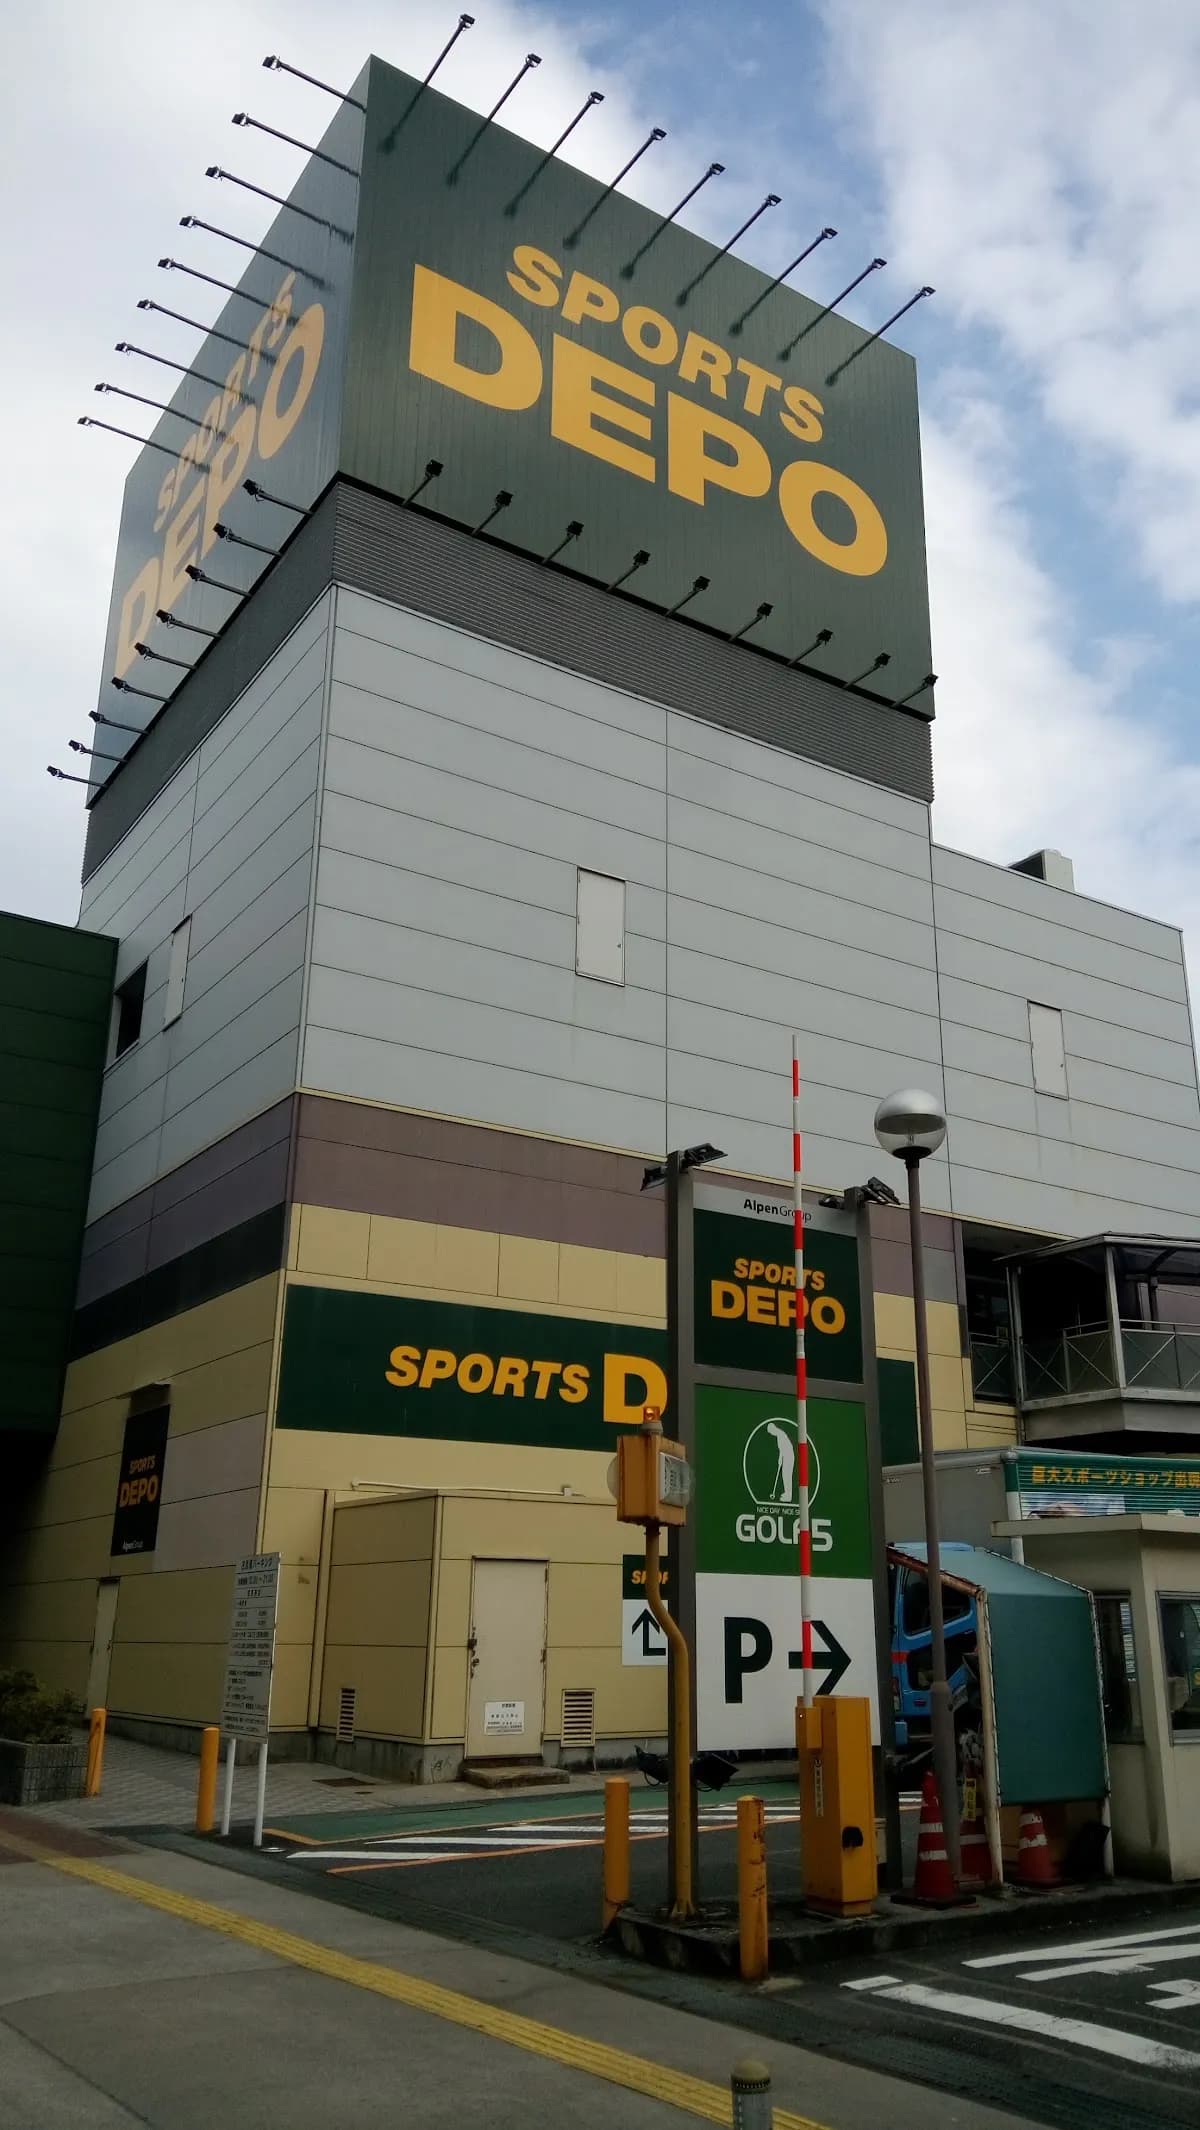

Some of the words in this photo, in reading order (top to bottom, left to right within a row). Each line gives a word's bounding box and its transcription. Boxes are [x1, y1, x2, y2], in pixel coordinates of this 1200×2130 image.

[506, 245, 824, 443] SPORTS
[154, 271, 297, 532] SPORTS
[409, 264, 888, 577] DEPO
[114, 302, 326, 679] DEPO
[711, 1279, 846, 1334] DEPO
[734, 1258, 826, 1292] SPORTS
[385, 1345, 590, 1403] SPORTS
[118, 1474, 158, 1508] DEPO
[129, 1454, 156, 1475] SPORTS
[724, 1616, 773, 1704] P
